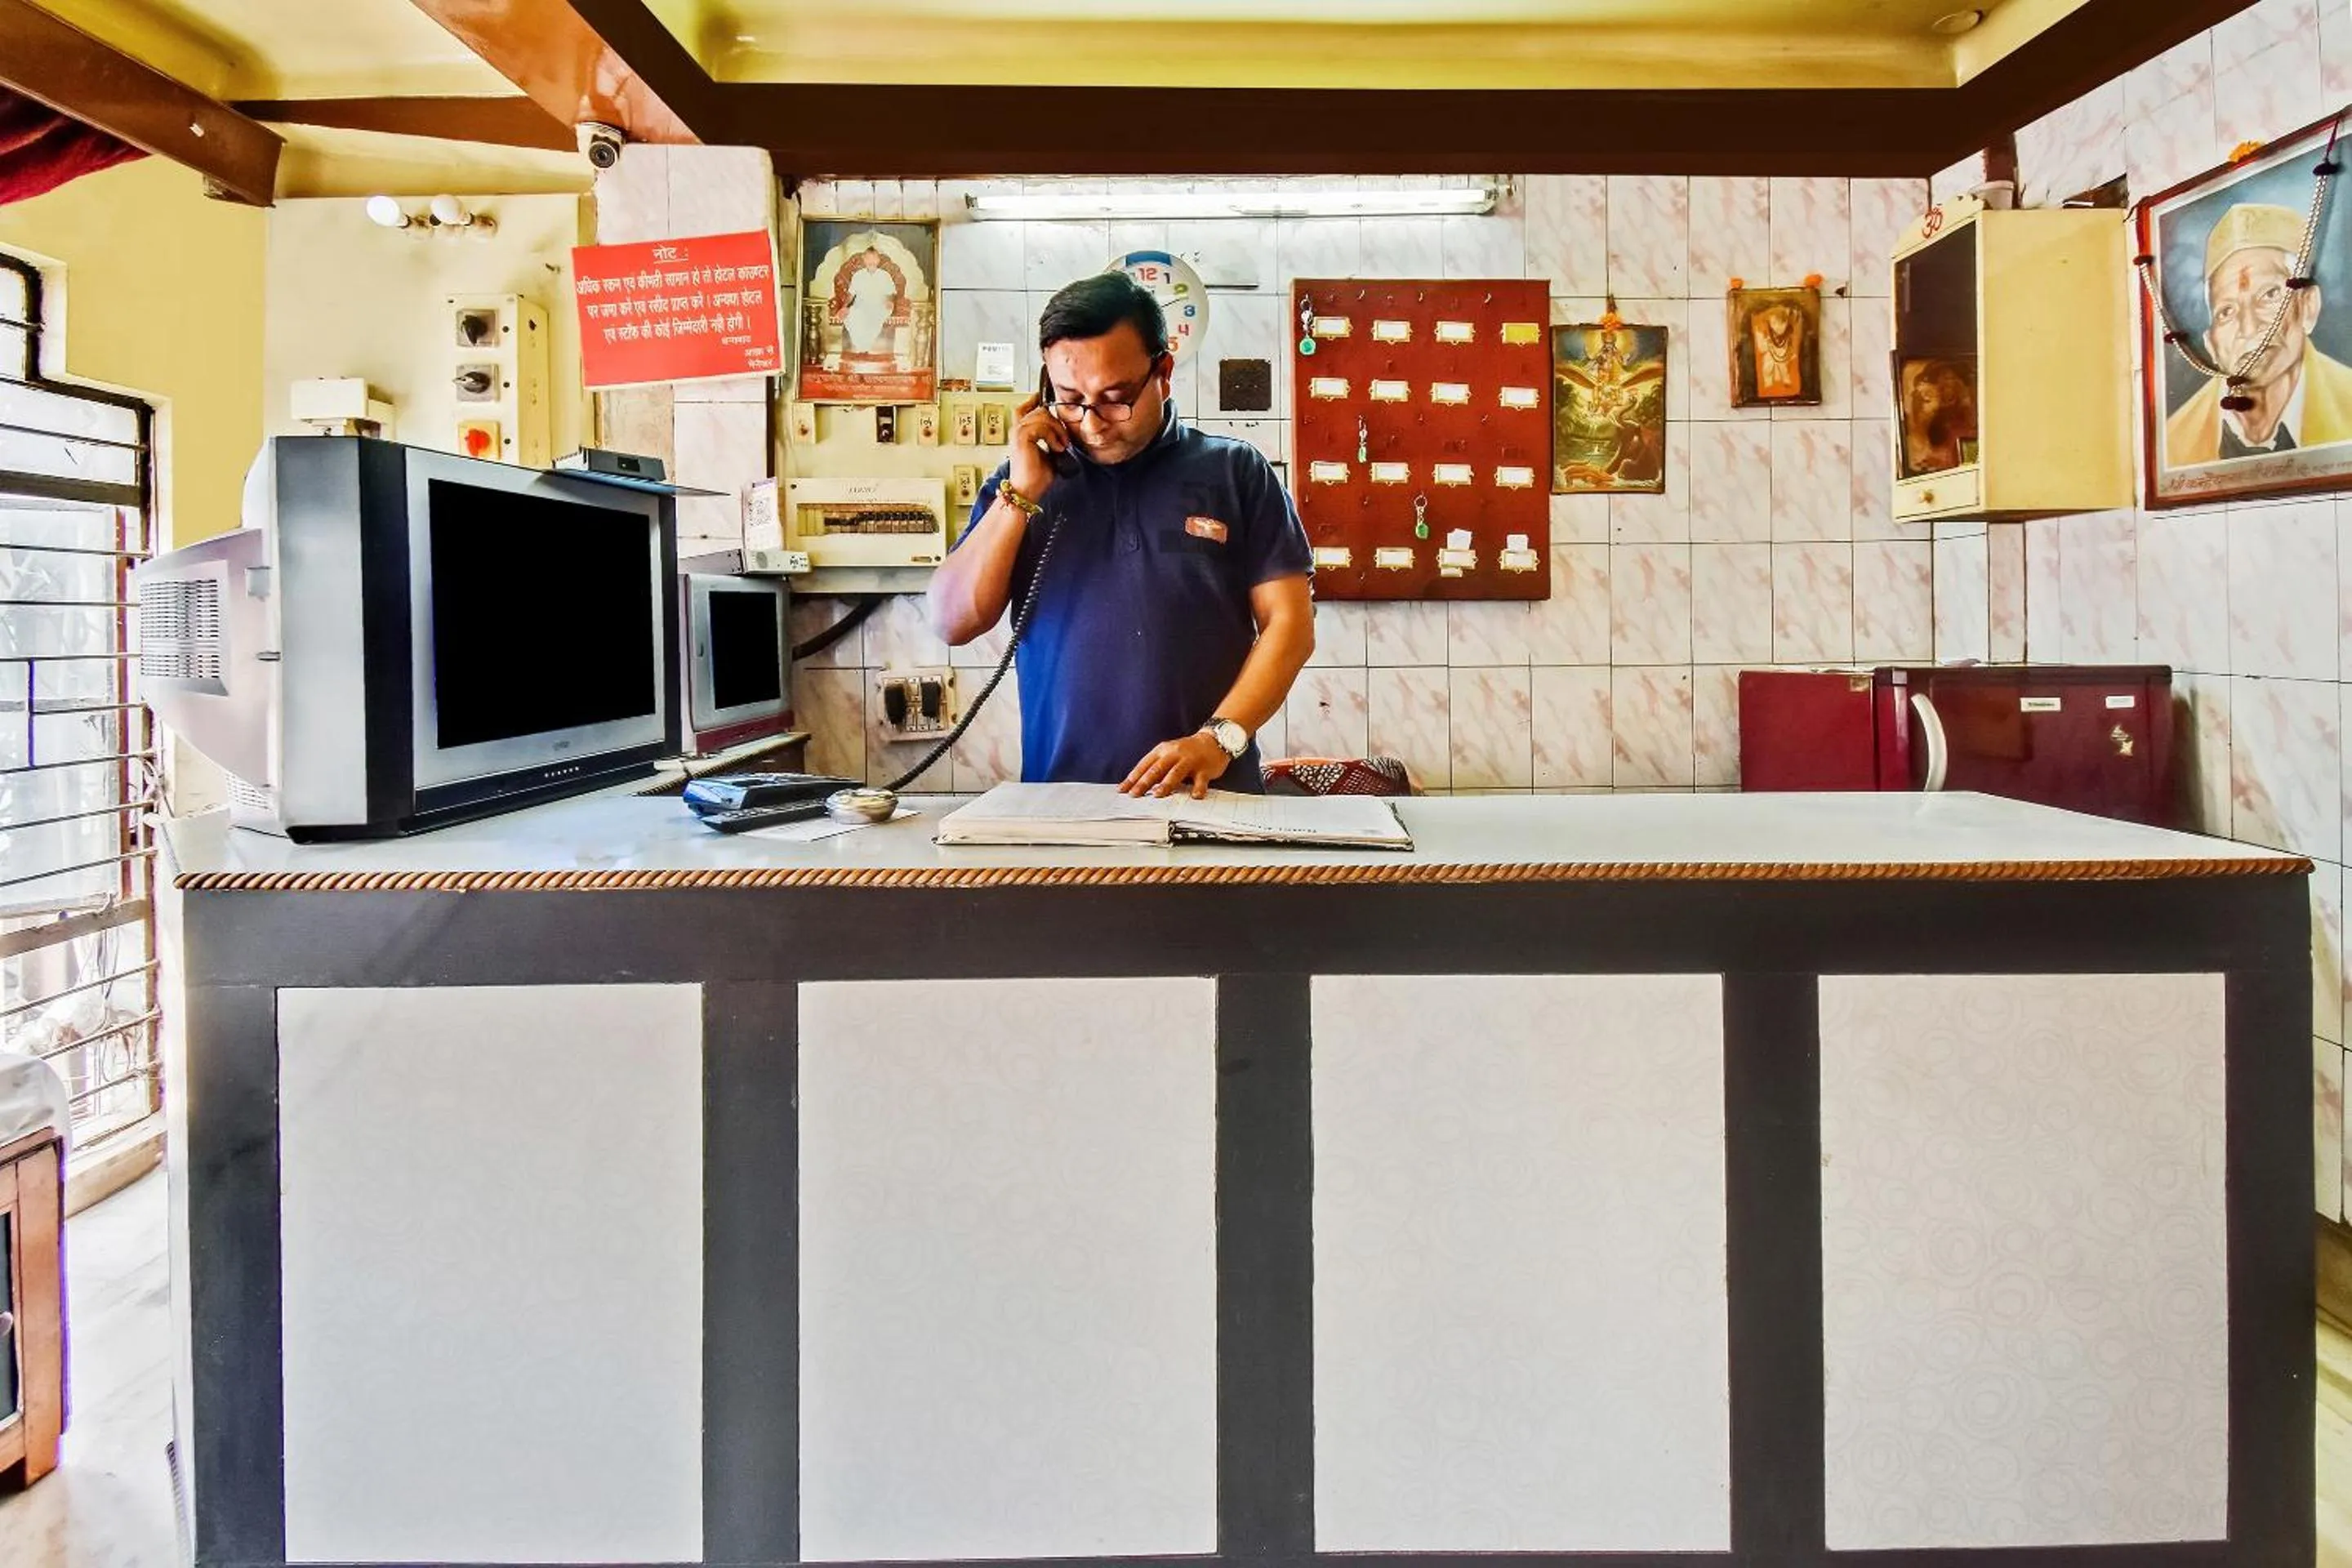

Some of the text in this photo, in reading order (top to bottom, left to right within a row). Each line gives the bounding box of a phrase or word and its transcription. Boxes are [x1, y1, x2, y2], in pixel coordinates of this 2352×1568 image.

[577, 277, 601, 295] अधिक
[603, 278, 621, 293] रकम
[638, 270, 662, 290] कीमती
[665, 272, 690, 287] सामान
[714, 264, 735, 284] होटल
[1138, 268, 1158, 281] 12
[1164, 272, 1170, 284] 1
[1174, 284, 1188, 301] 2
[587, 305, 599, 320] पर
[601, 303, 618, 318] जमा
[648, 294, 670, 314] रसीद
[1184, 305, 1196, 317] 3
[641, 320, 653, 340] की
[1178, 324, 1189, 336] 4
